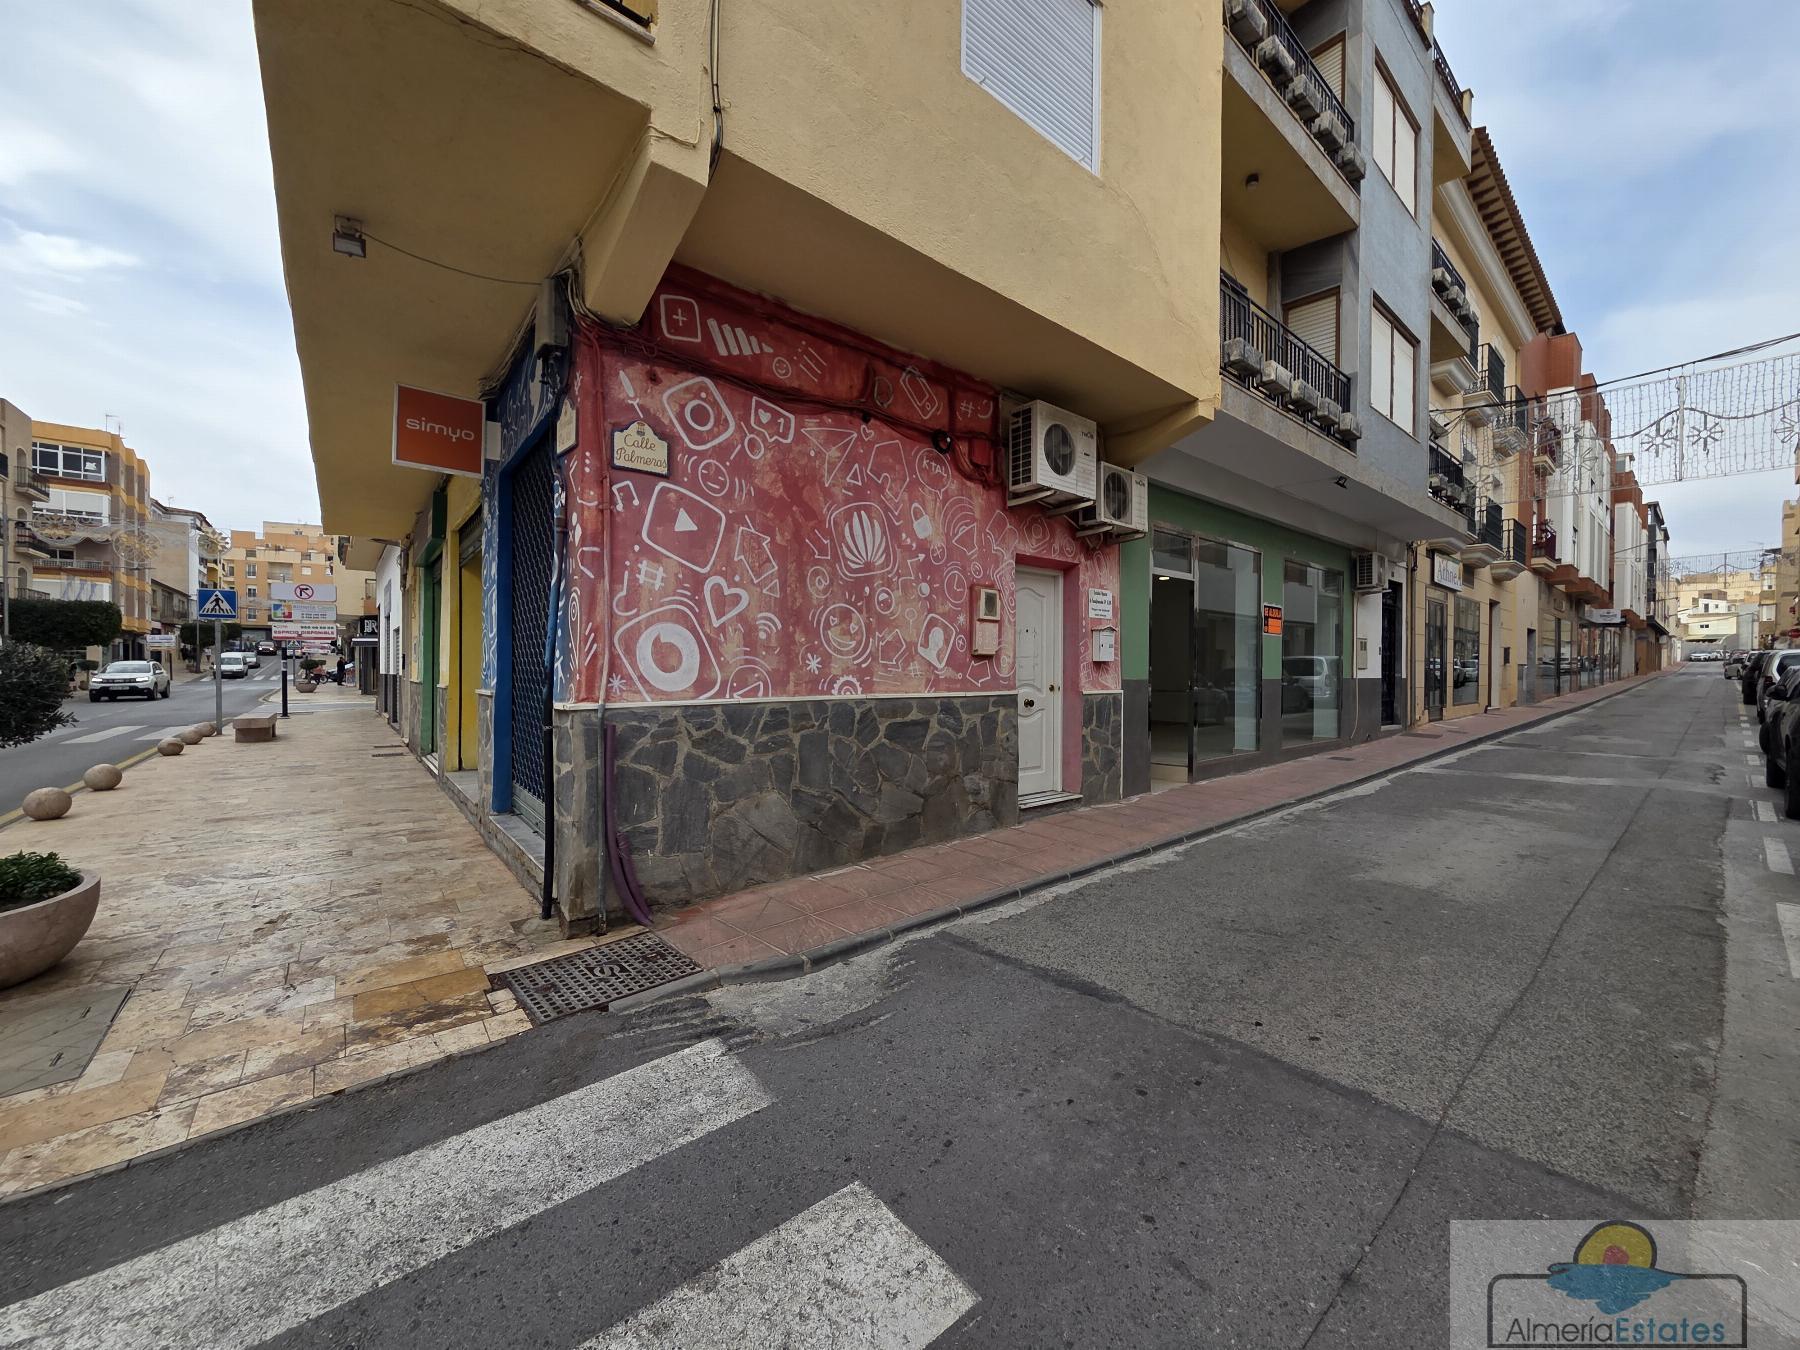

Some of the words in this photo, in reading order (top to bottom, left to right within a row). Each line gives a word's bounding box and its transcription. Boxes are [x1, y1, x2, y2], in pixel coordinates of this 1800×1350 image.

[405, 417, 475, 443] simyo
[623, 434, 656, 451] Calle
[615, 447, 667, 468] Palmeras
